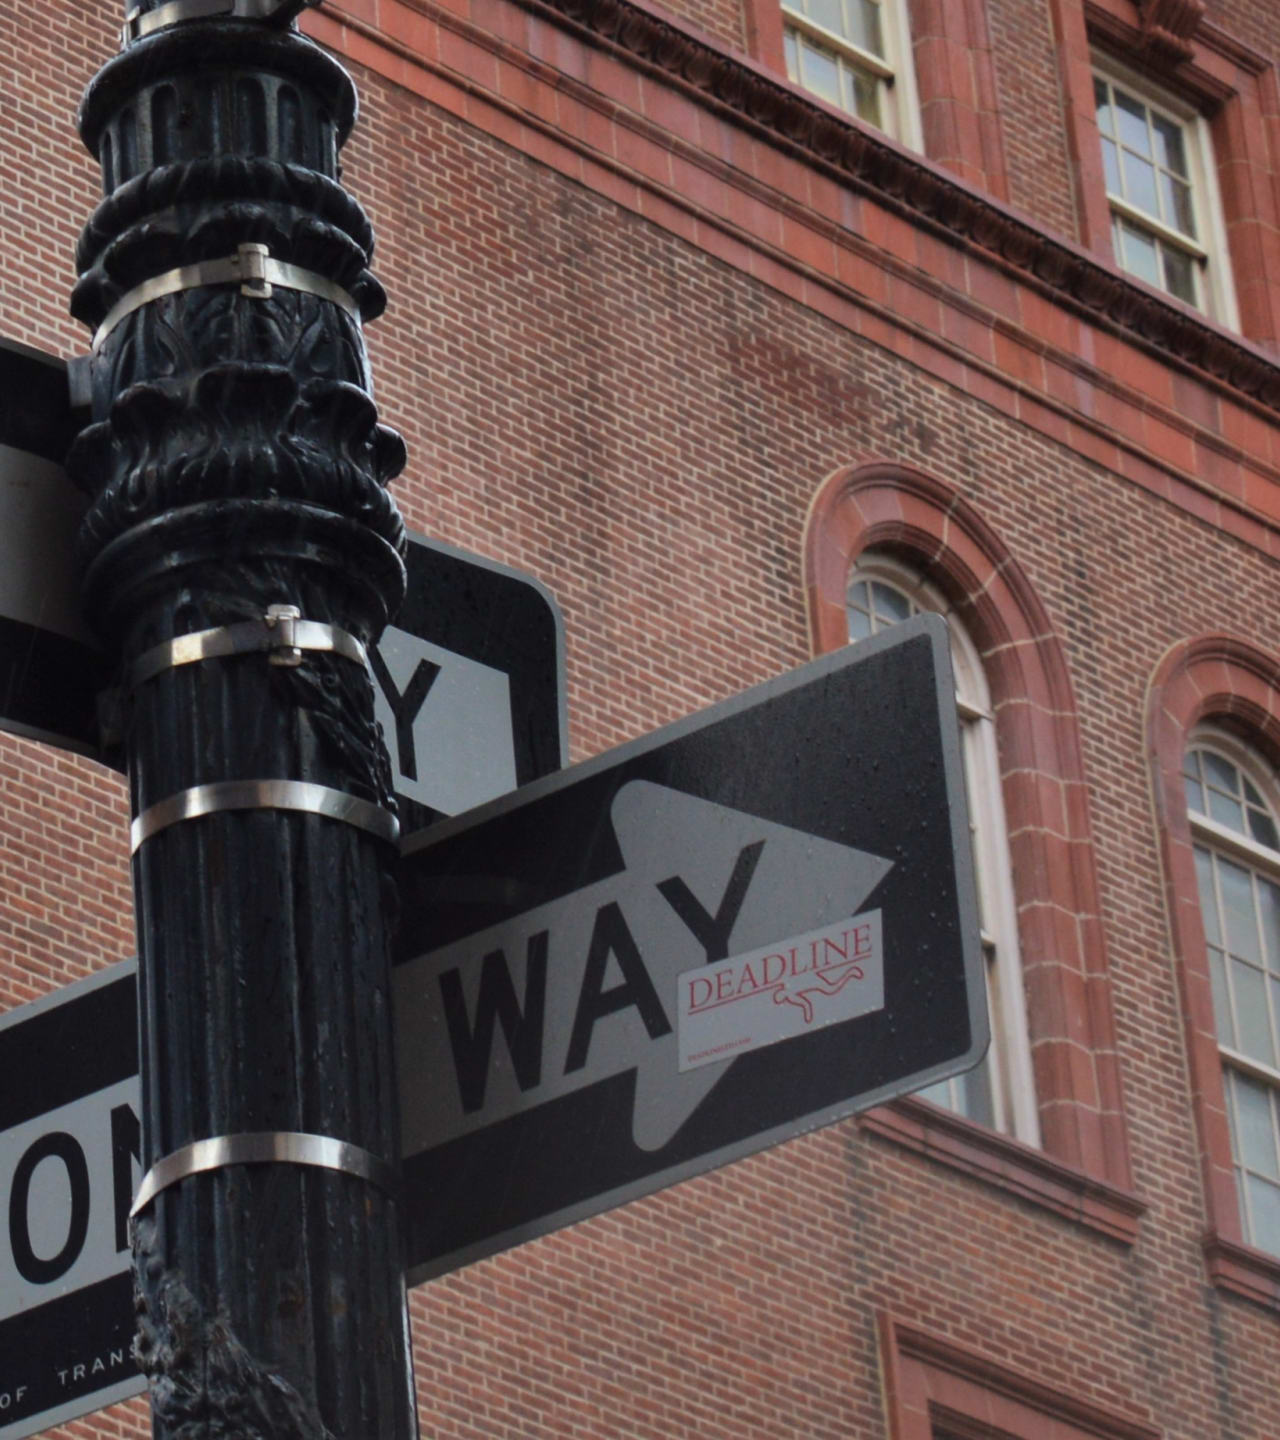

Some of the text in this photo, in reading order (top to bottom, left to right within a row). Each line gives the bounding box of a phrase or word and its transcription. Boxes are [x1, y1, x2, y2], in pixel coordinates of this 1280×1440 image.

[440, 839, 767, 1116] WAY
[688, 924, 873, 1010] DEADLINE
[0, 1387, 27, 1408] OF
